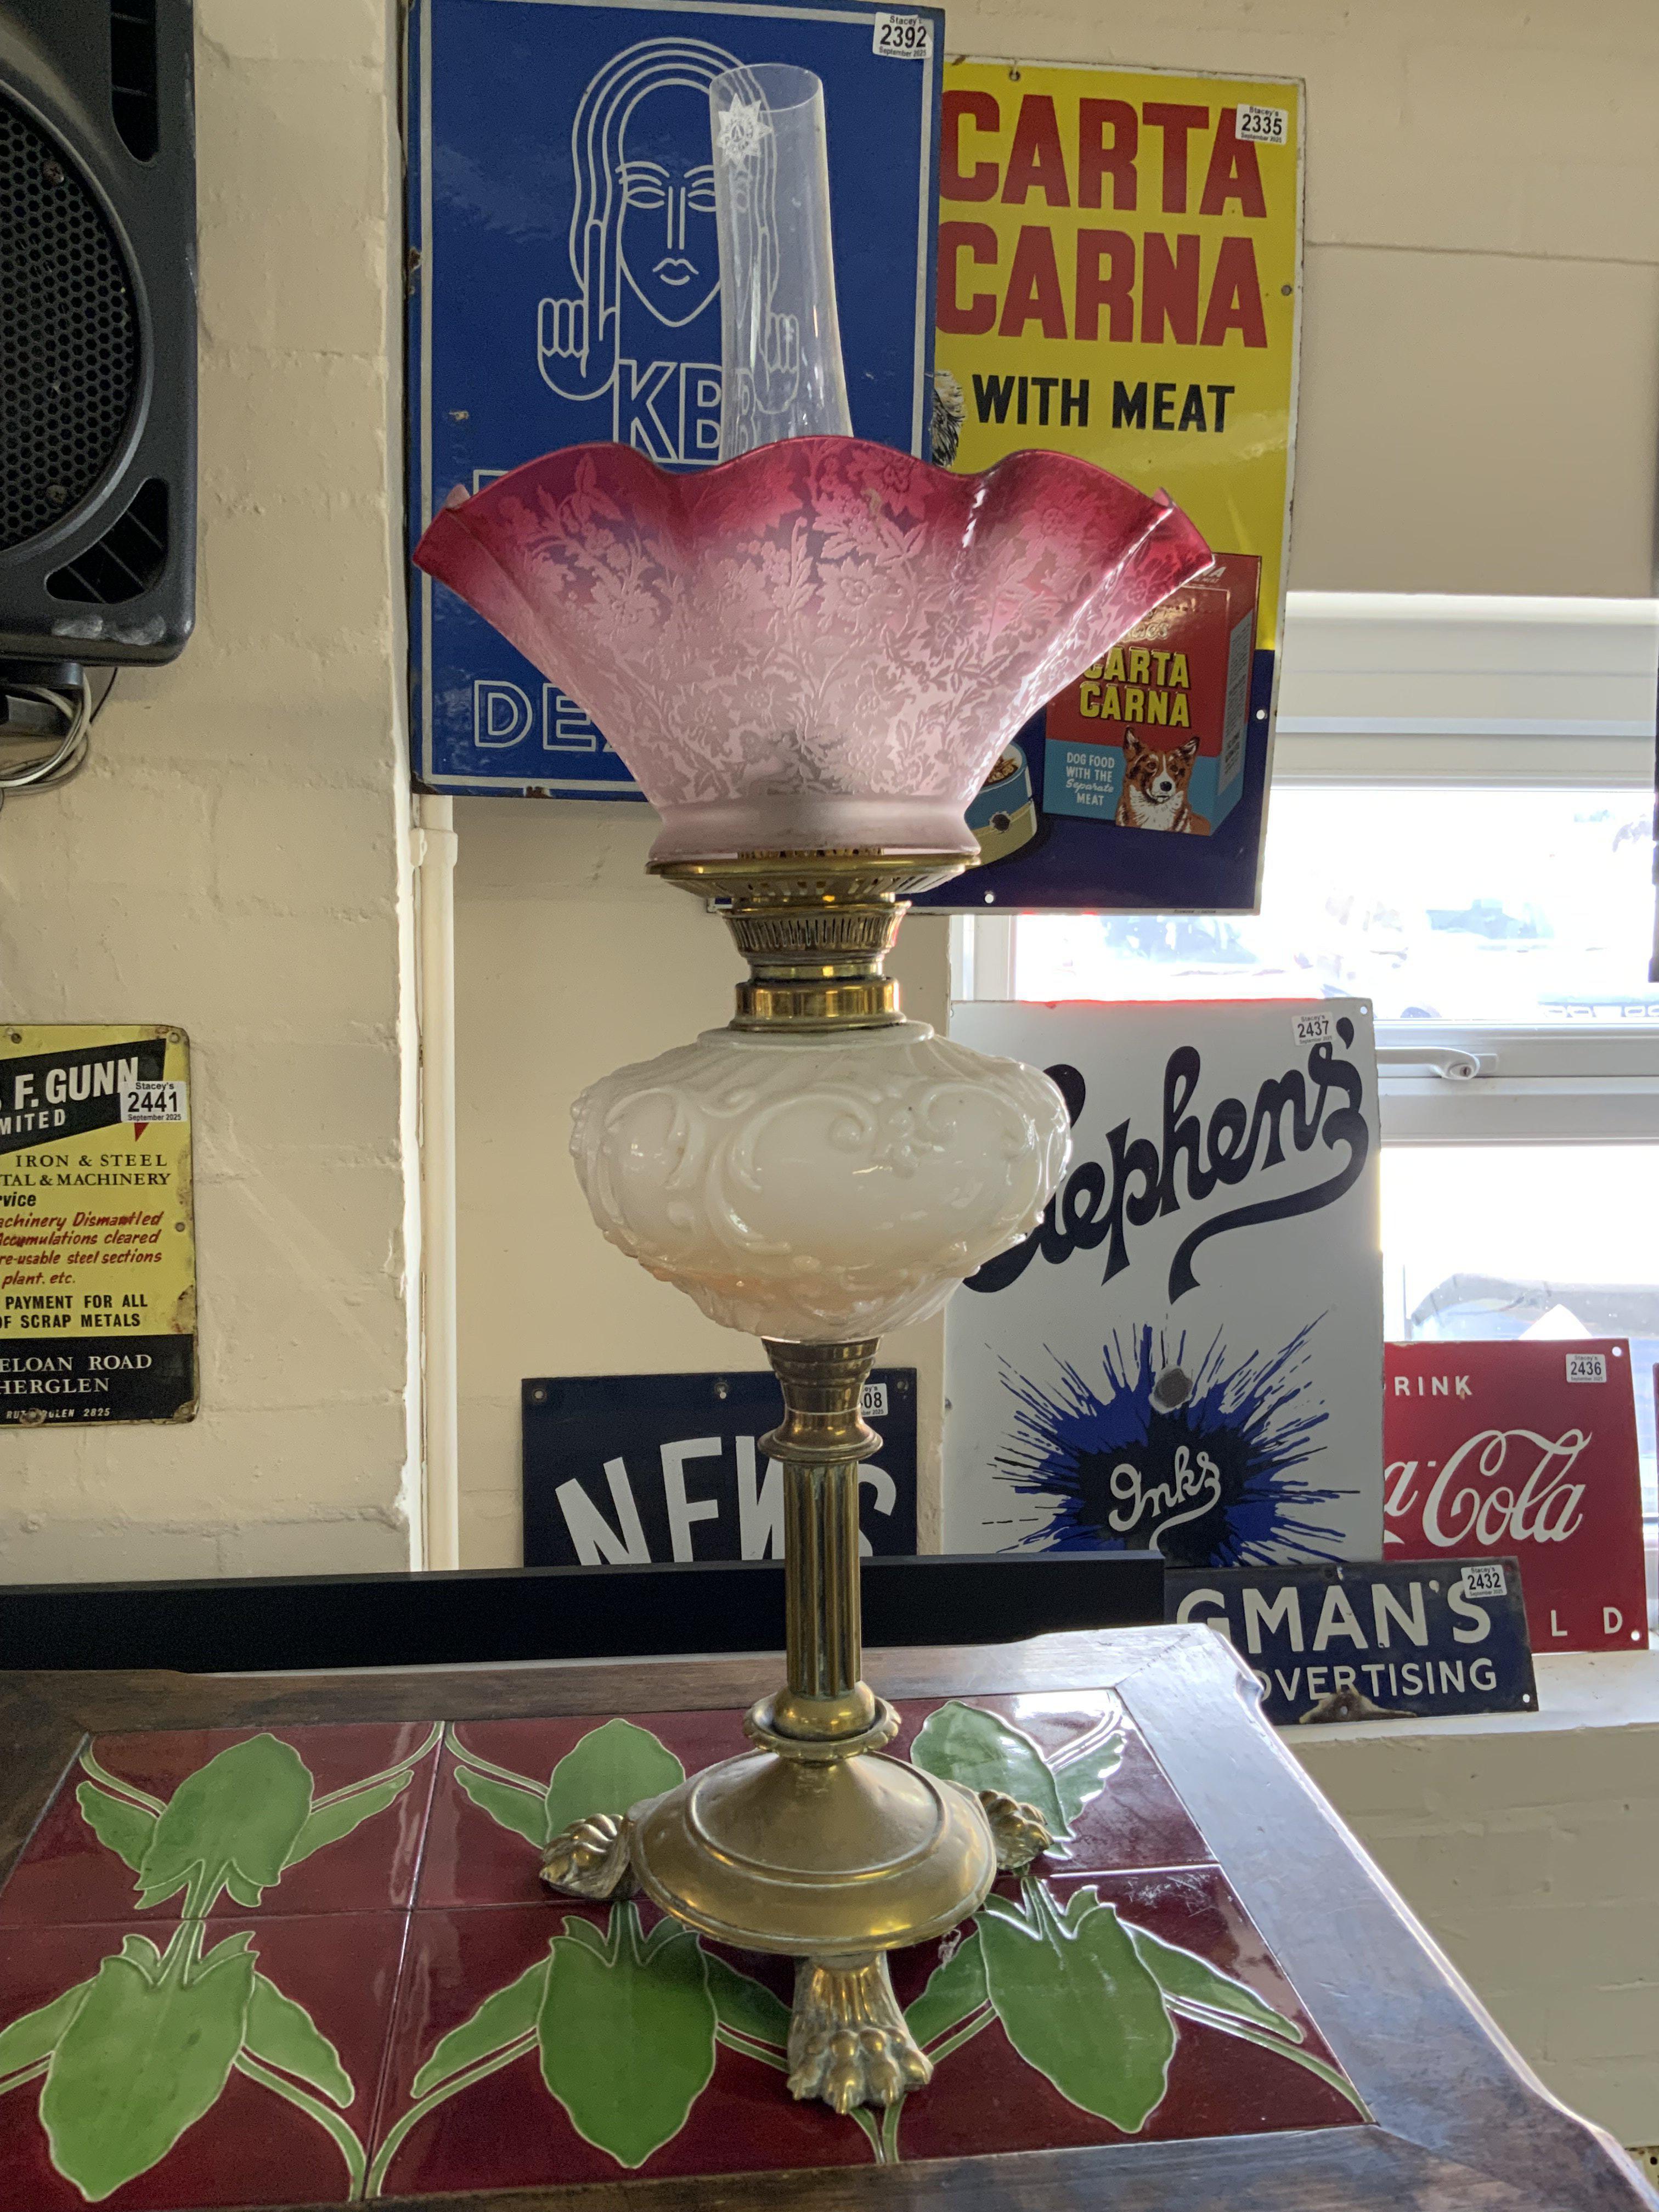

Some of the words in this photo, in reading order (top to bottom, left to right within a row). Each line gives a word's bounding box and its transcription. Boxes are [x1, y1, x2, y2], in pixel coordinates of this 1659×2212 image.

[880, 24, 927, 48] 2392
[1242, 114, 1282, 135] 2335
[939, 89, 1267, 218] CARTA
[935, 221, 1268, 348] CARNA
[972, 374, 1090, 427] WITH
[1111, 380, 1235, 433] MEAT
[1080, 681, 1190, 727] CARNA
[1066, 752, 1086, 765] DOG
[1089, 755, 1115, 768] FOOD
[1066, 766, 1091, 779] WITH
[1094, 769, 1113, 782] THE
[1066, 778, 1114, 793] Separate
[1076, 793, 1104, 806] MEAT
[1297, 1020, 1329, 1038] 2437
[136, 1082, 174, 1091] Stacey's
[128, 1091, 178, 1113] 2441
[16, 1155, 69, 1167] IRON
[78, 1155, 92, 1166] &
[100, 1154, 167, 1167] STEEL
[0, 1174, 36, 1186] TAL
[40, 1175, 54, 1186] &
[57, 1173, 171, 1186] MACHINERY
[0, 1191, 36, 1207] vice
[72, 1211, 164, 1226] Dismantled
[104, 1229, 162, 1244] cleared
[67, 1251, 100, 1265] steel
[102, 1249, 162, 1263] sections
[49, 1272, 76, 1284] etc.
[5, 1295, 73, 1310] PAYMENT
[84, 1295, 112, 1308] FOR
[122, 1294, 148, 1307] ALL
[21, 1314, 71, 1328] SCRAP
[81, 1313, 140, 1327] METALS
[0, 1357, 74, 1372] ELOAN
[88, 1355, 153, 1370] ROAD
[1571, 1361, 1601, 1375] 2436
[1383, 1375, 1472, 1396] RINK
[860, 1392, 882, 1408] 08
[6, 1409, 75, 1419] RUTRGLEN
[83, 1407, 111, 1417] 2825
[1108, 1444, 1221, 1550] Inks
[1468, 1572, 1502, 1590] 2432
[1176, 1579, 1492, 1654] GMAN'S
